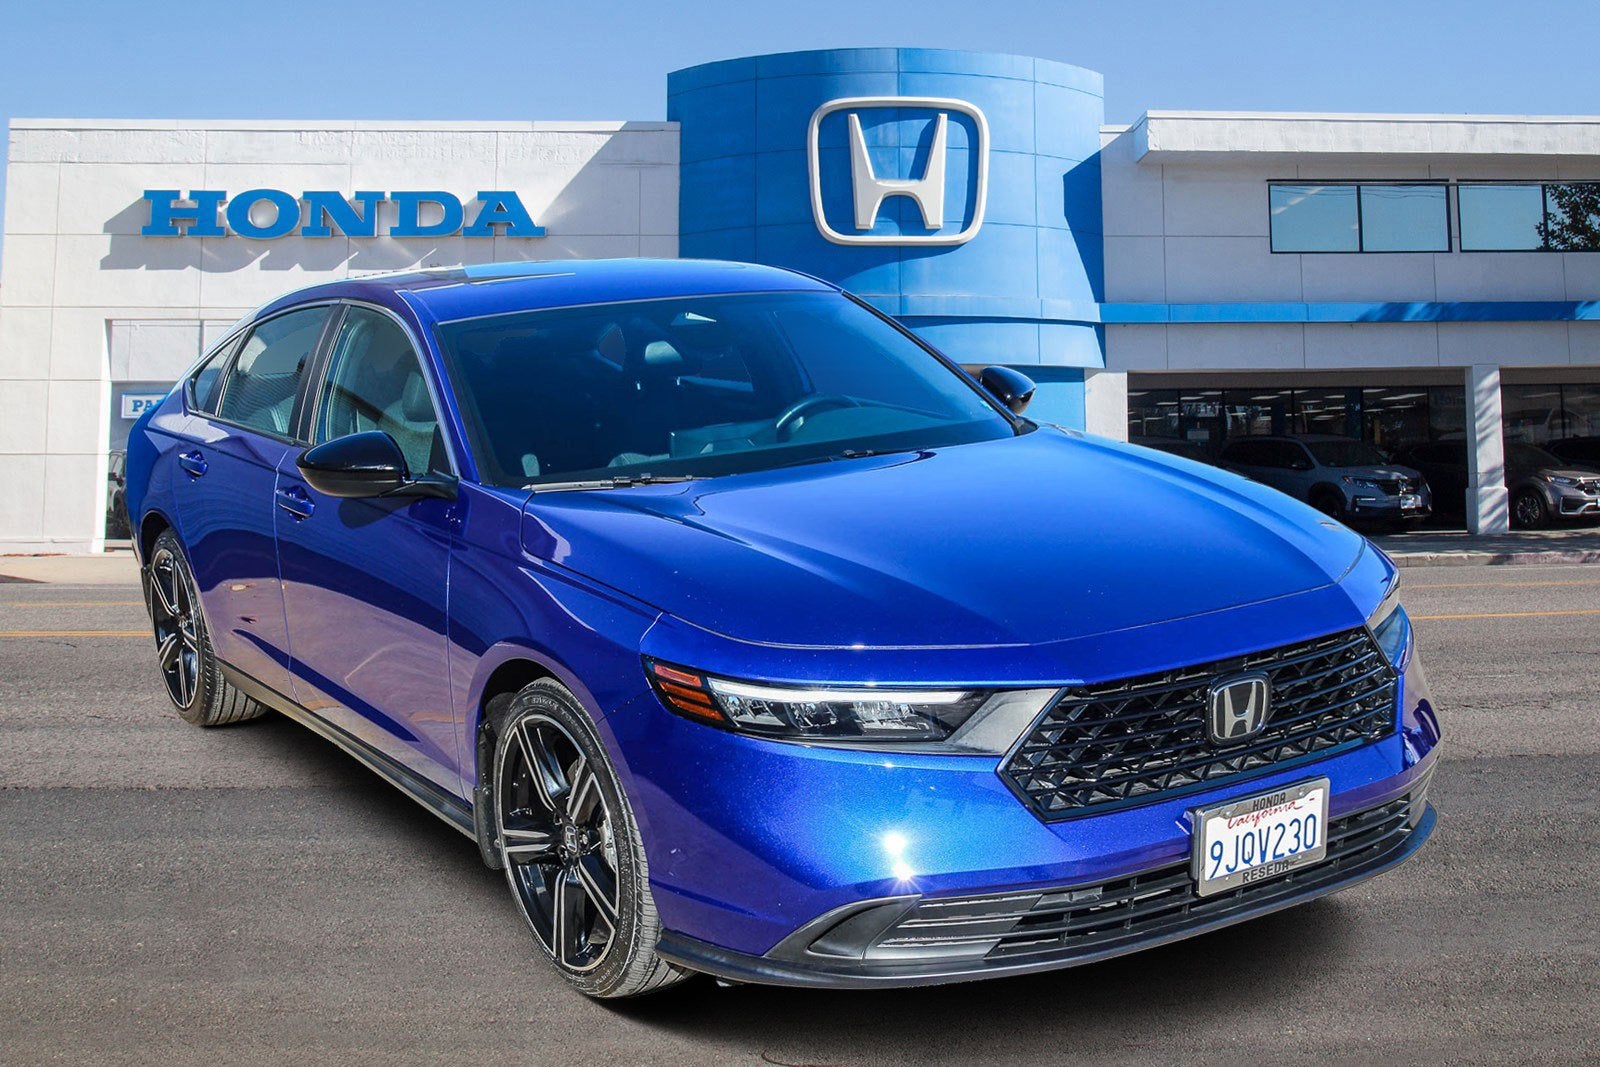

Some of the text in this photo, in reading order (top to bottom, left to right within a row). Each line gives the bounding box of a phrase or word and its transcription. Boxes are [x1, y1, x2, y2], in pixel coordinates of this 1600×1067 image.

[141, 188, 548, 240] HONDA
[131, 399, 161, 413] PA
[1252, 791, 1287, 811] HONDA
[1227, 800, 1303, 830] California
[1210, 813, 1317, 879] 9JQV230
[1242, 859, 1290, 884] RESEDA
